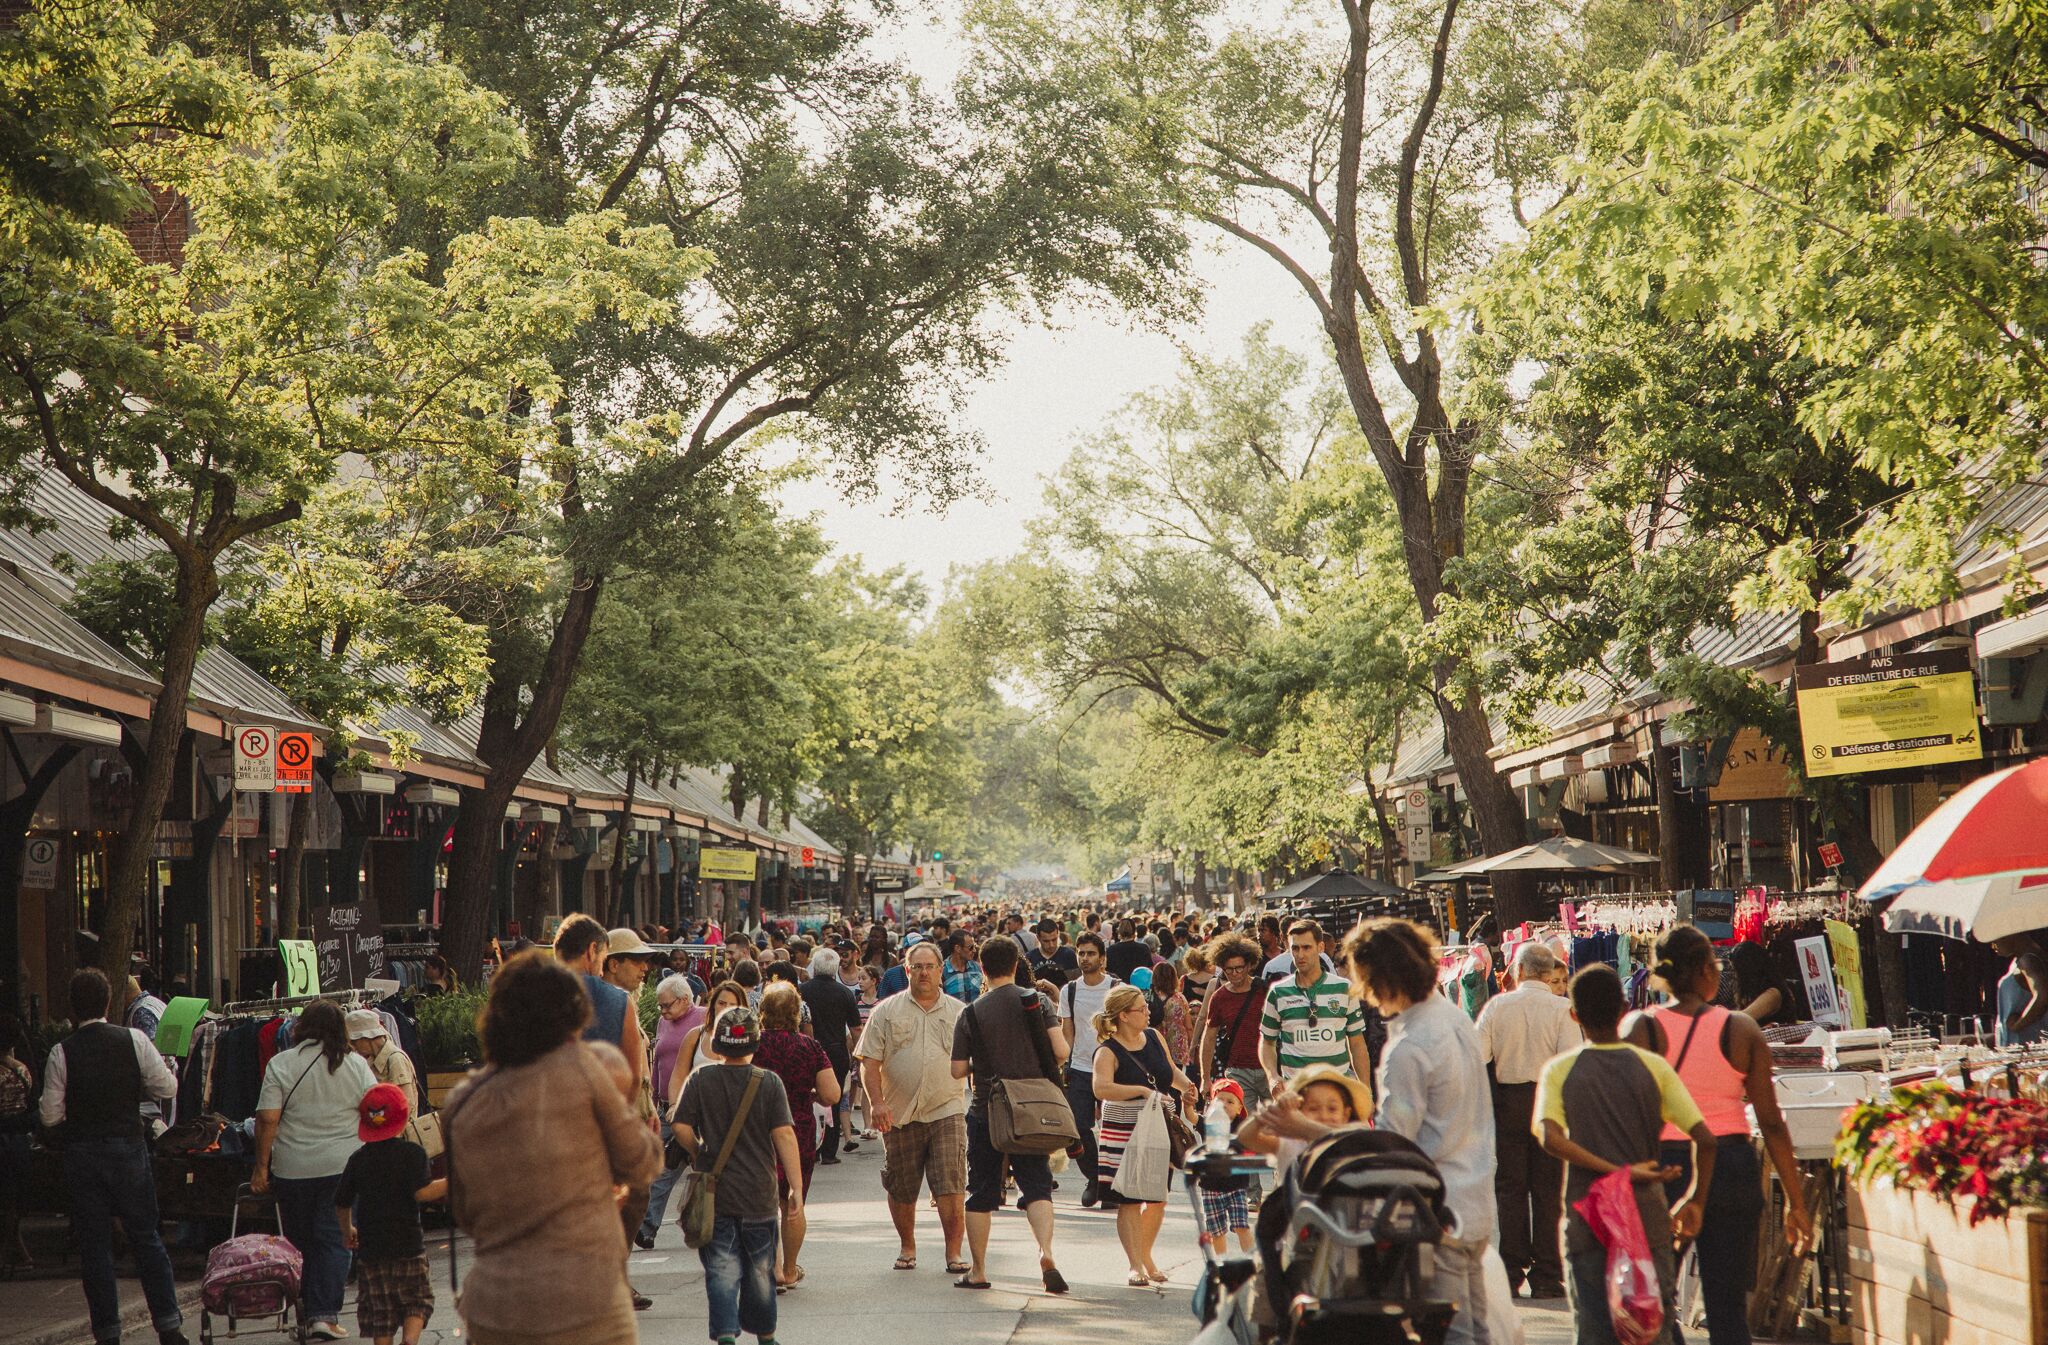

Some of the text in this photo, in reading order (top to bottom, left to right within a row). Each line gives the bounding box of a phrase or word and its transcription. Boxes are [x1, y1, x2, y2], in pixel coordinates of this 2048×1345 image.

[1871, 657, 1893, 668] AVIS
[1828, 665, 1939, 687] DE FERMETURE DE RUE
[1879, 693, 1899, 702] juillet
[1900, 691, 1914, 699] 2017
[1841, 736, 1947, 756] Défense de stationner
[277, 770, 287, 780] 7h
[295, 770, 309, 780] 19h
[1414, 827, 1424, 840] P
[720, 1034, 750, 1044] Haters!
